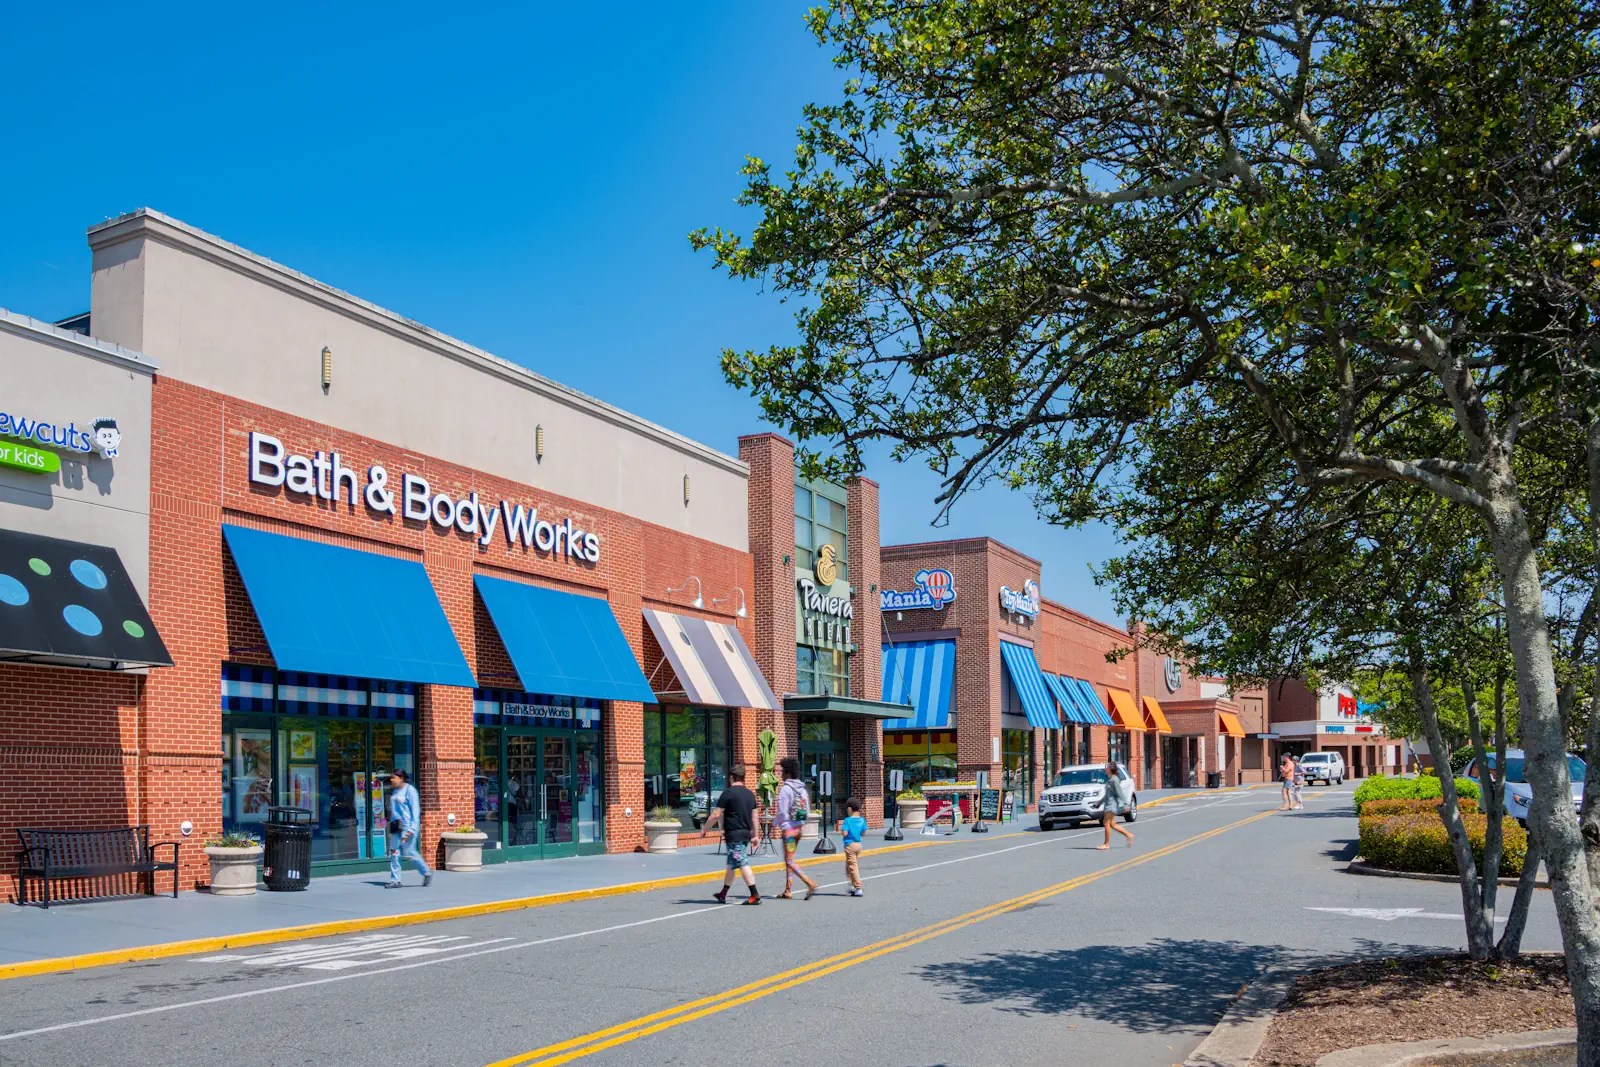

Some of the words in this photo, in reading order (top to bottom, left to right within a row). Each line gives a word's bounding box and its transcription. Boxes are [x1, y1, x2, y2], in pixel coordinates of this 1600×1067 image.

[14, 447, 45, 467] kids
[249, 431, 359, 505] Bath
[364, 465, 397, 515] &
[402, 473, 499, 545] Body
[500, 499, 600, 563] Works
[799, 578, 853, 620] Panera
[880, 589, 932, 608] Mania
[505, 703, 523, 715] Bath
[523, 705, 529, 715] &
[529, 705, 548, 718] Body
[548, 707, 571, 718] Works
